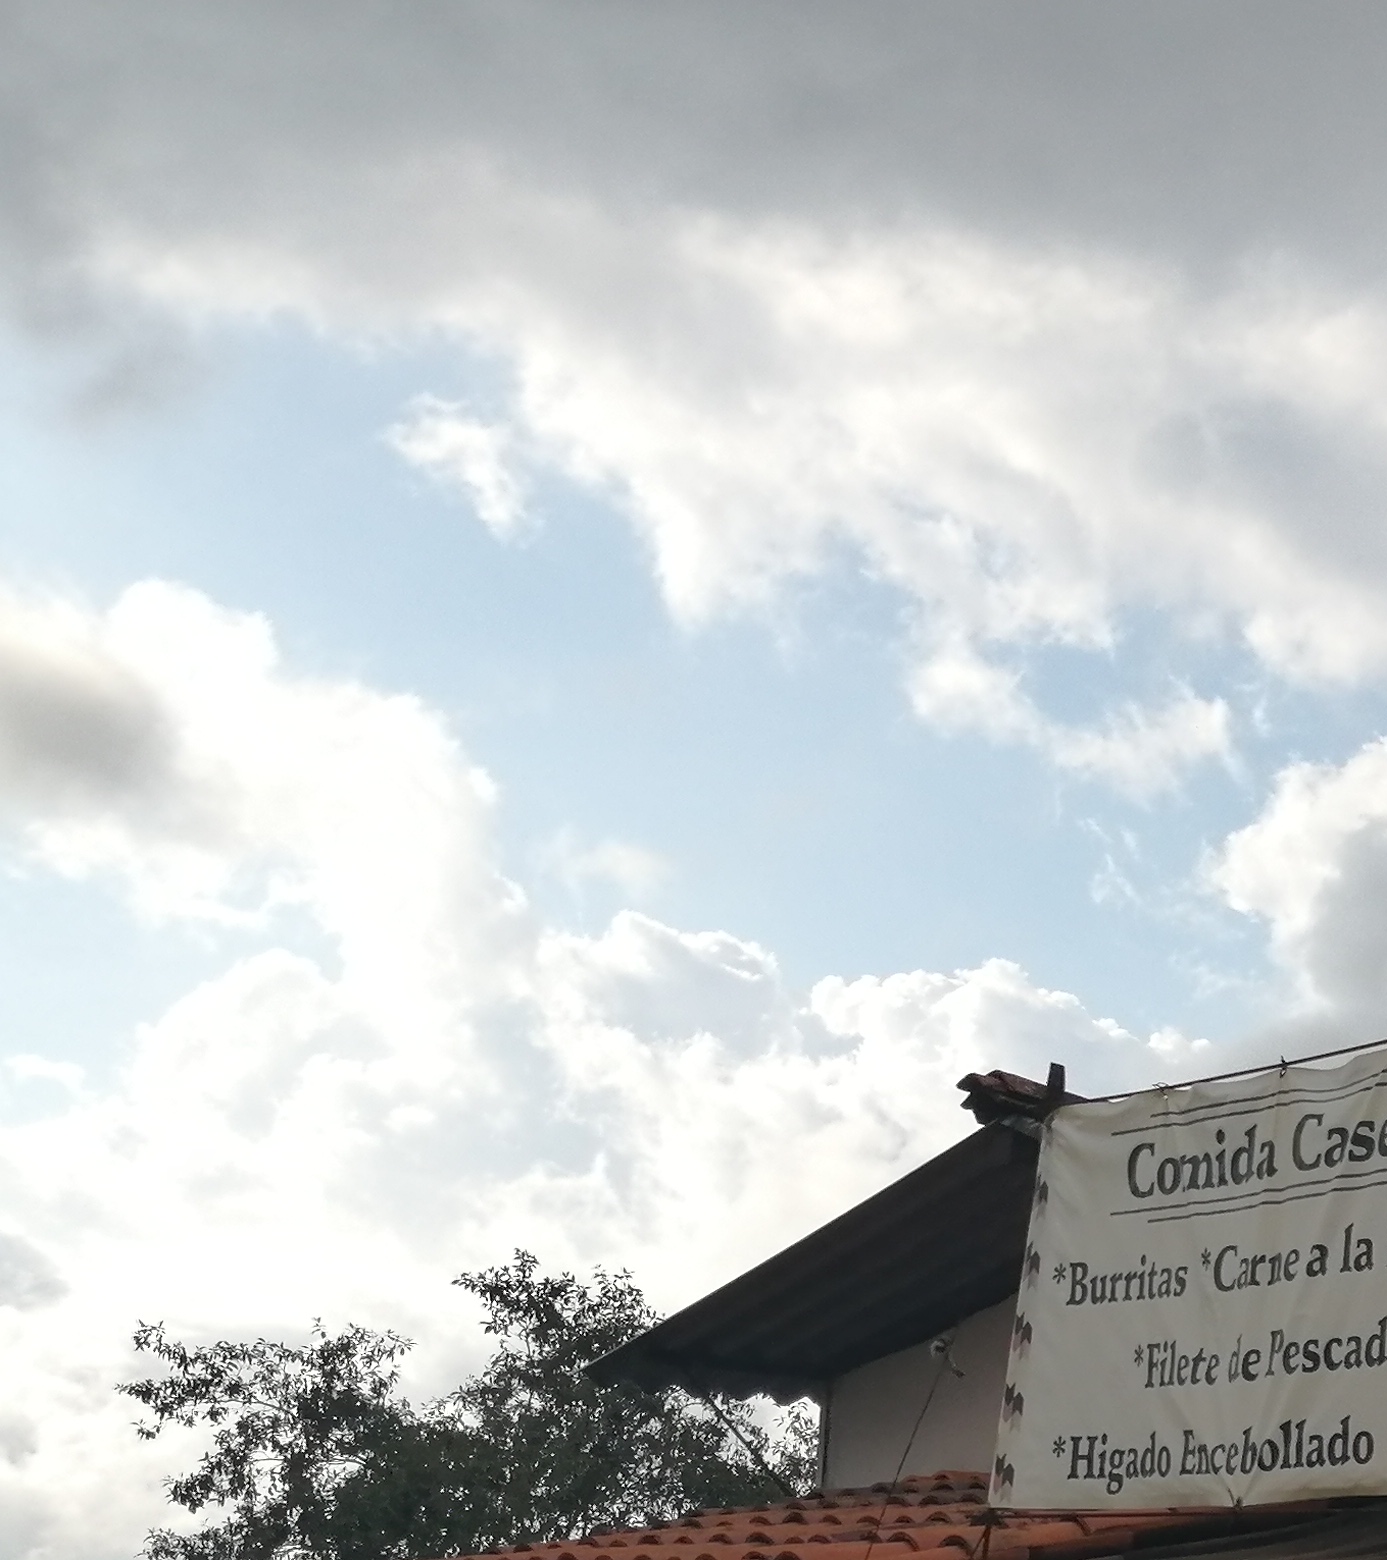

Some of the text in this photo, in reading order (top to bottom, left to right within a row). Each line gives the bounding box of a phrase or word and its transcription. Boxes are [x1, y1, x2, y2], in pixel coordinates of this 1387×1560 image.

[1305, 1245, 1329, 1279] a
[1340, 1222, 1375, 1274] la
[1228, 1333, 1262, 1384] de
[1179, 1414, 1375, 1476] Encebollado
